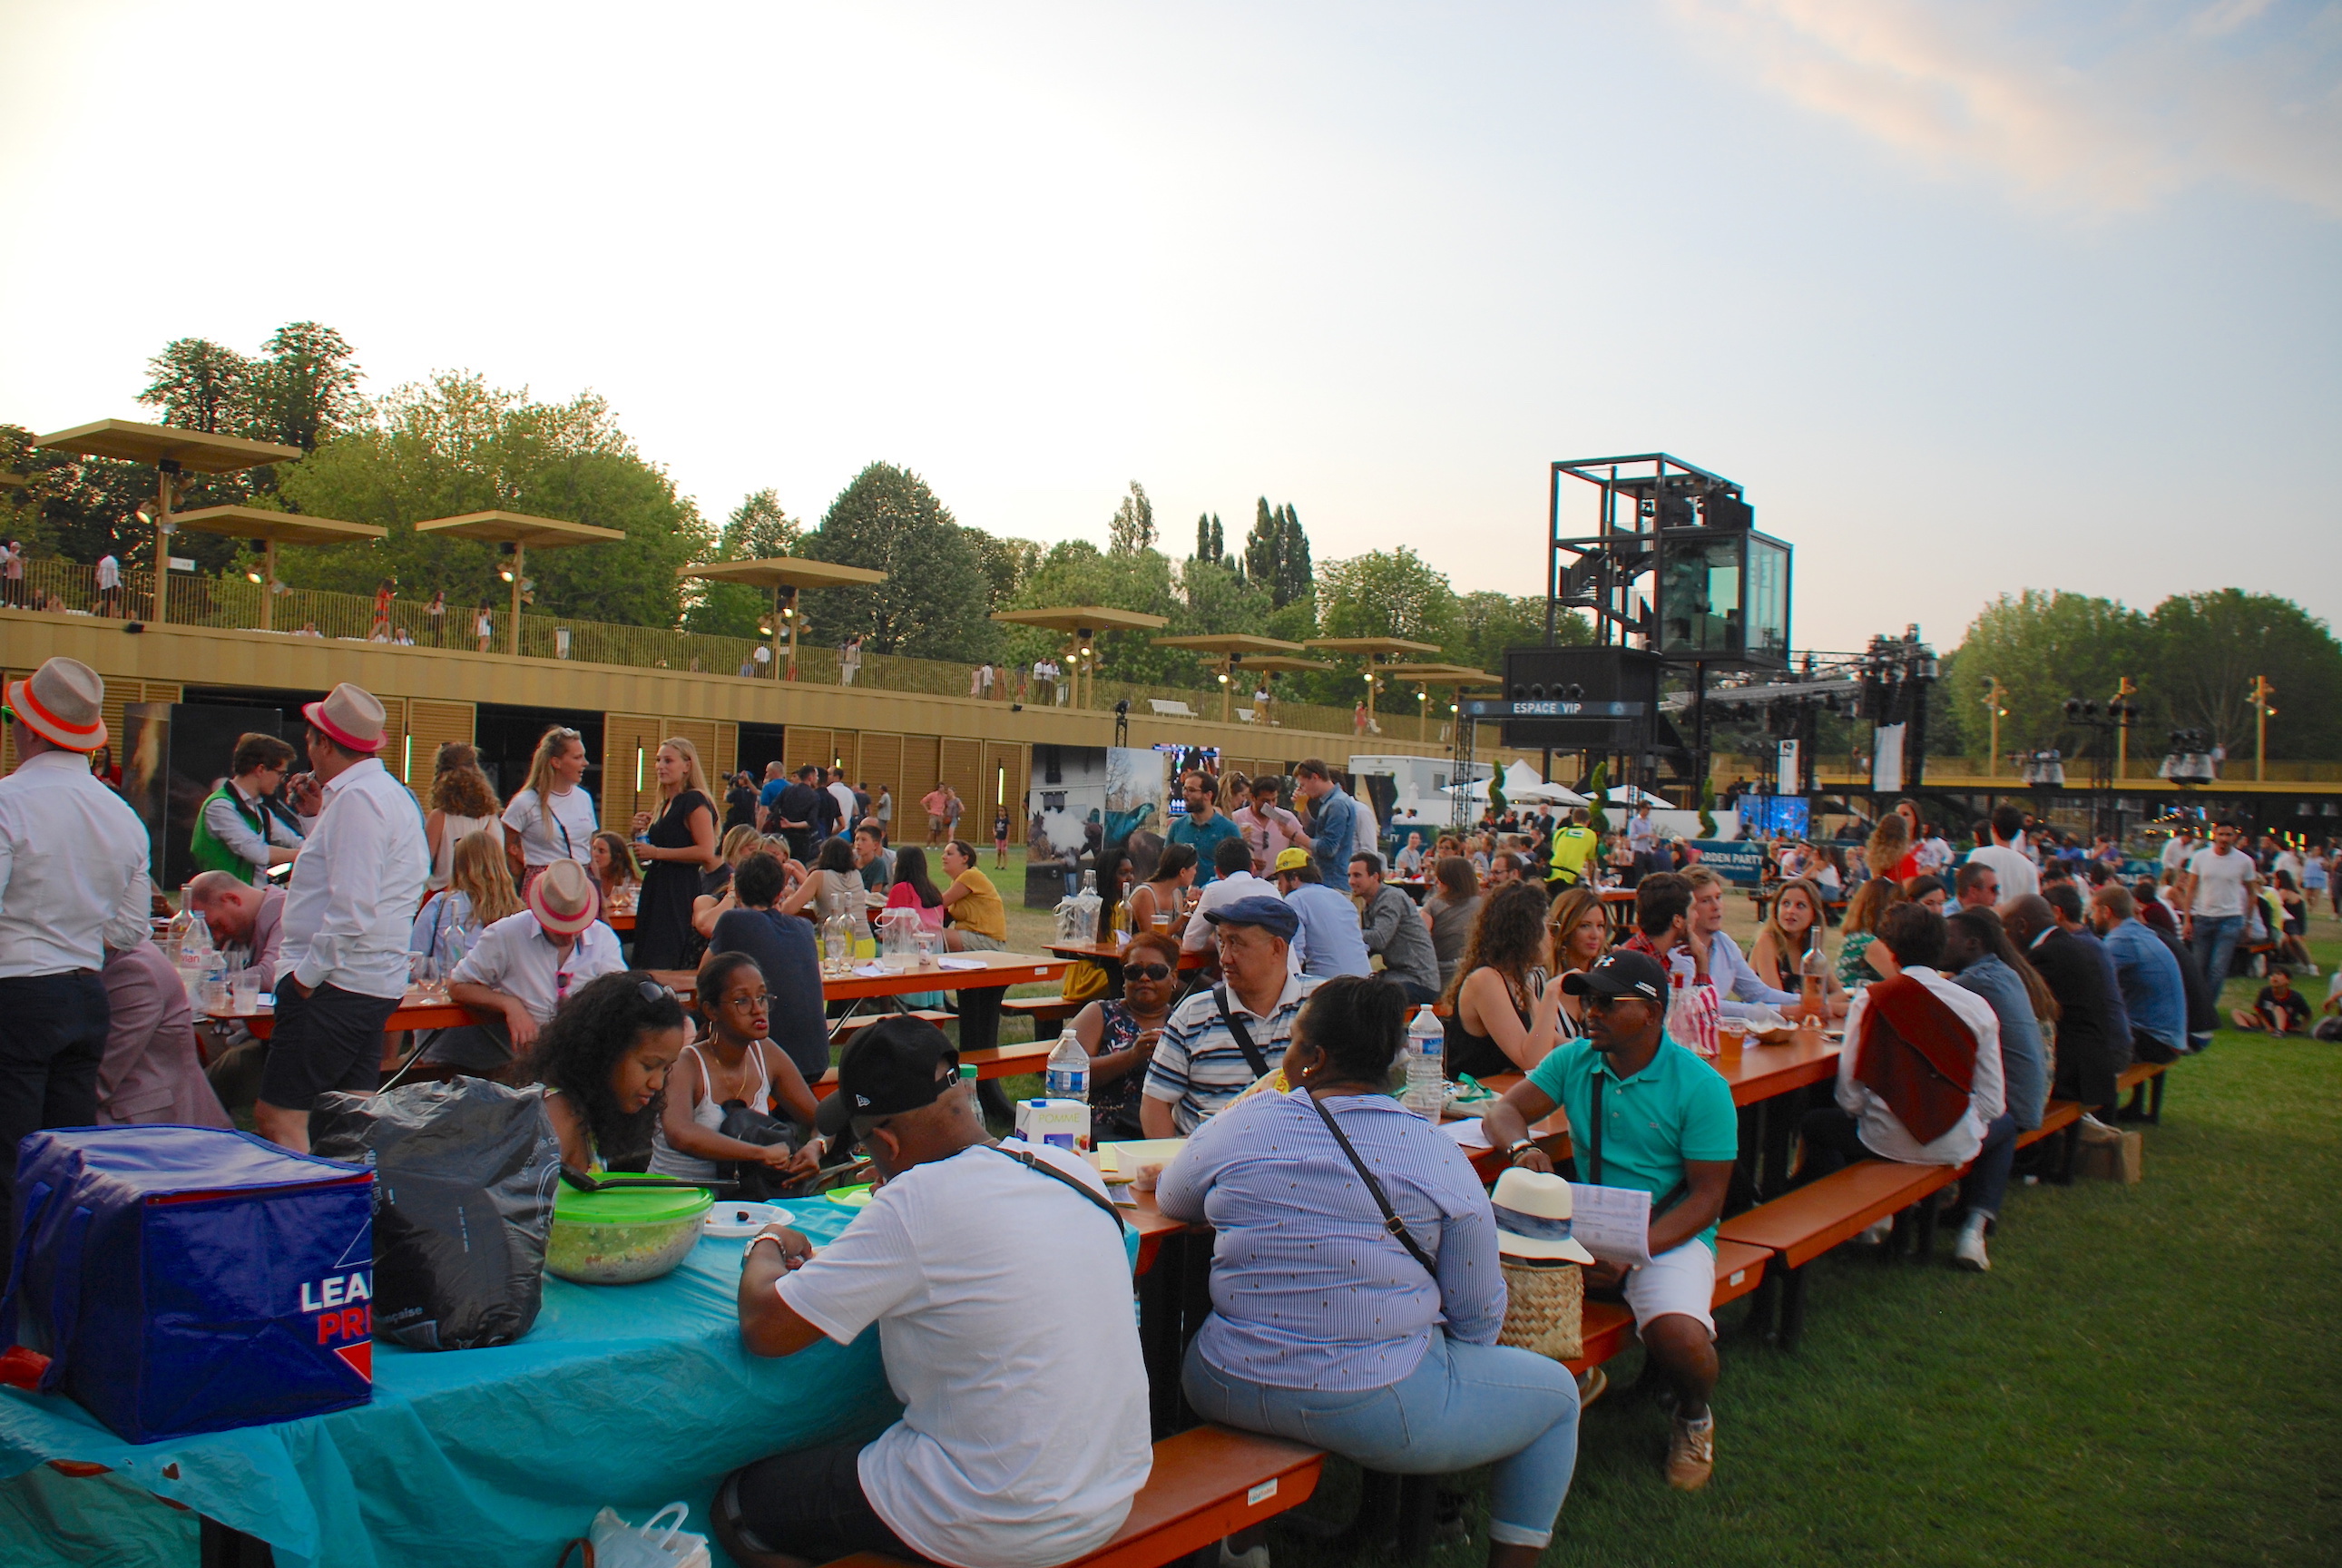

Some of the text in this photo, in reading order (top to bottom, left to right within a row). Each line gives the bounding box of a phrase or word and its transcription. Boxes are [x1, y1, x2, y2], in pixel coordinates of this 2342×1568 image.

[1514, 703, 1583, 713] ESPACE VIP
[1700, 852, 1763, 865] ARDEN PARTY
[1039, 1113, 1080, 1123] POMME
[302, 1271, 373, 1313] LEA
